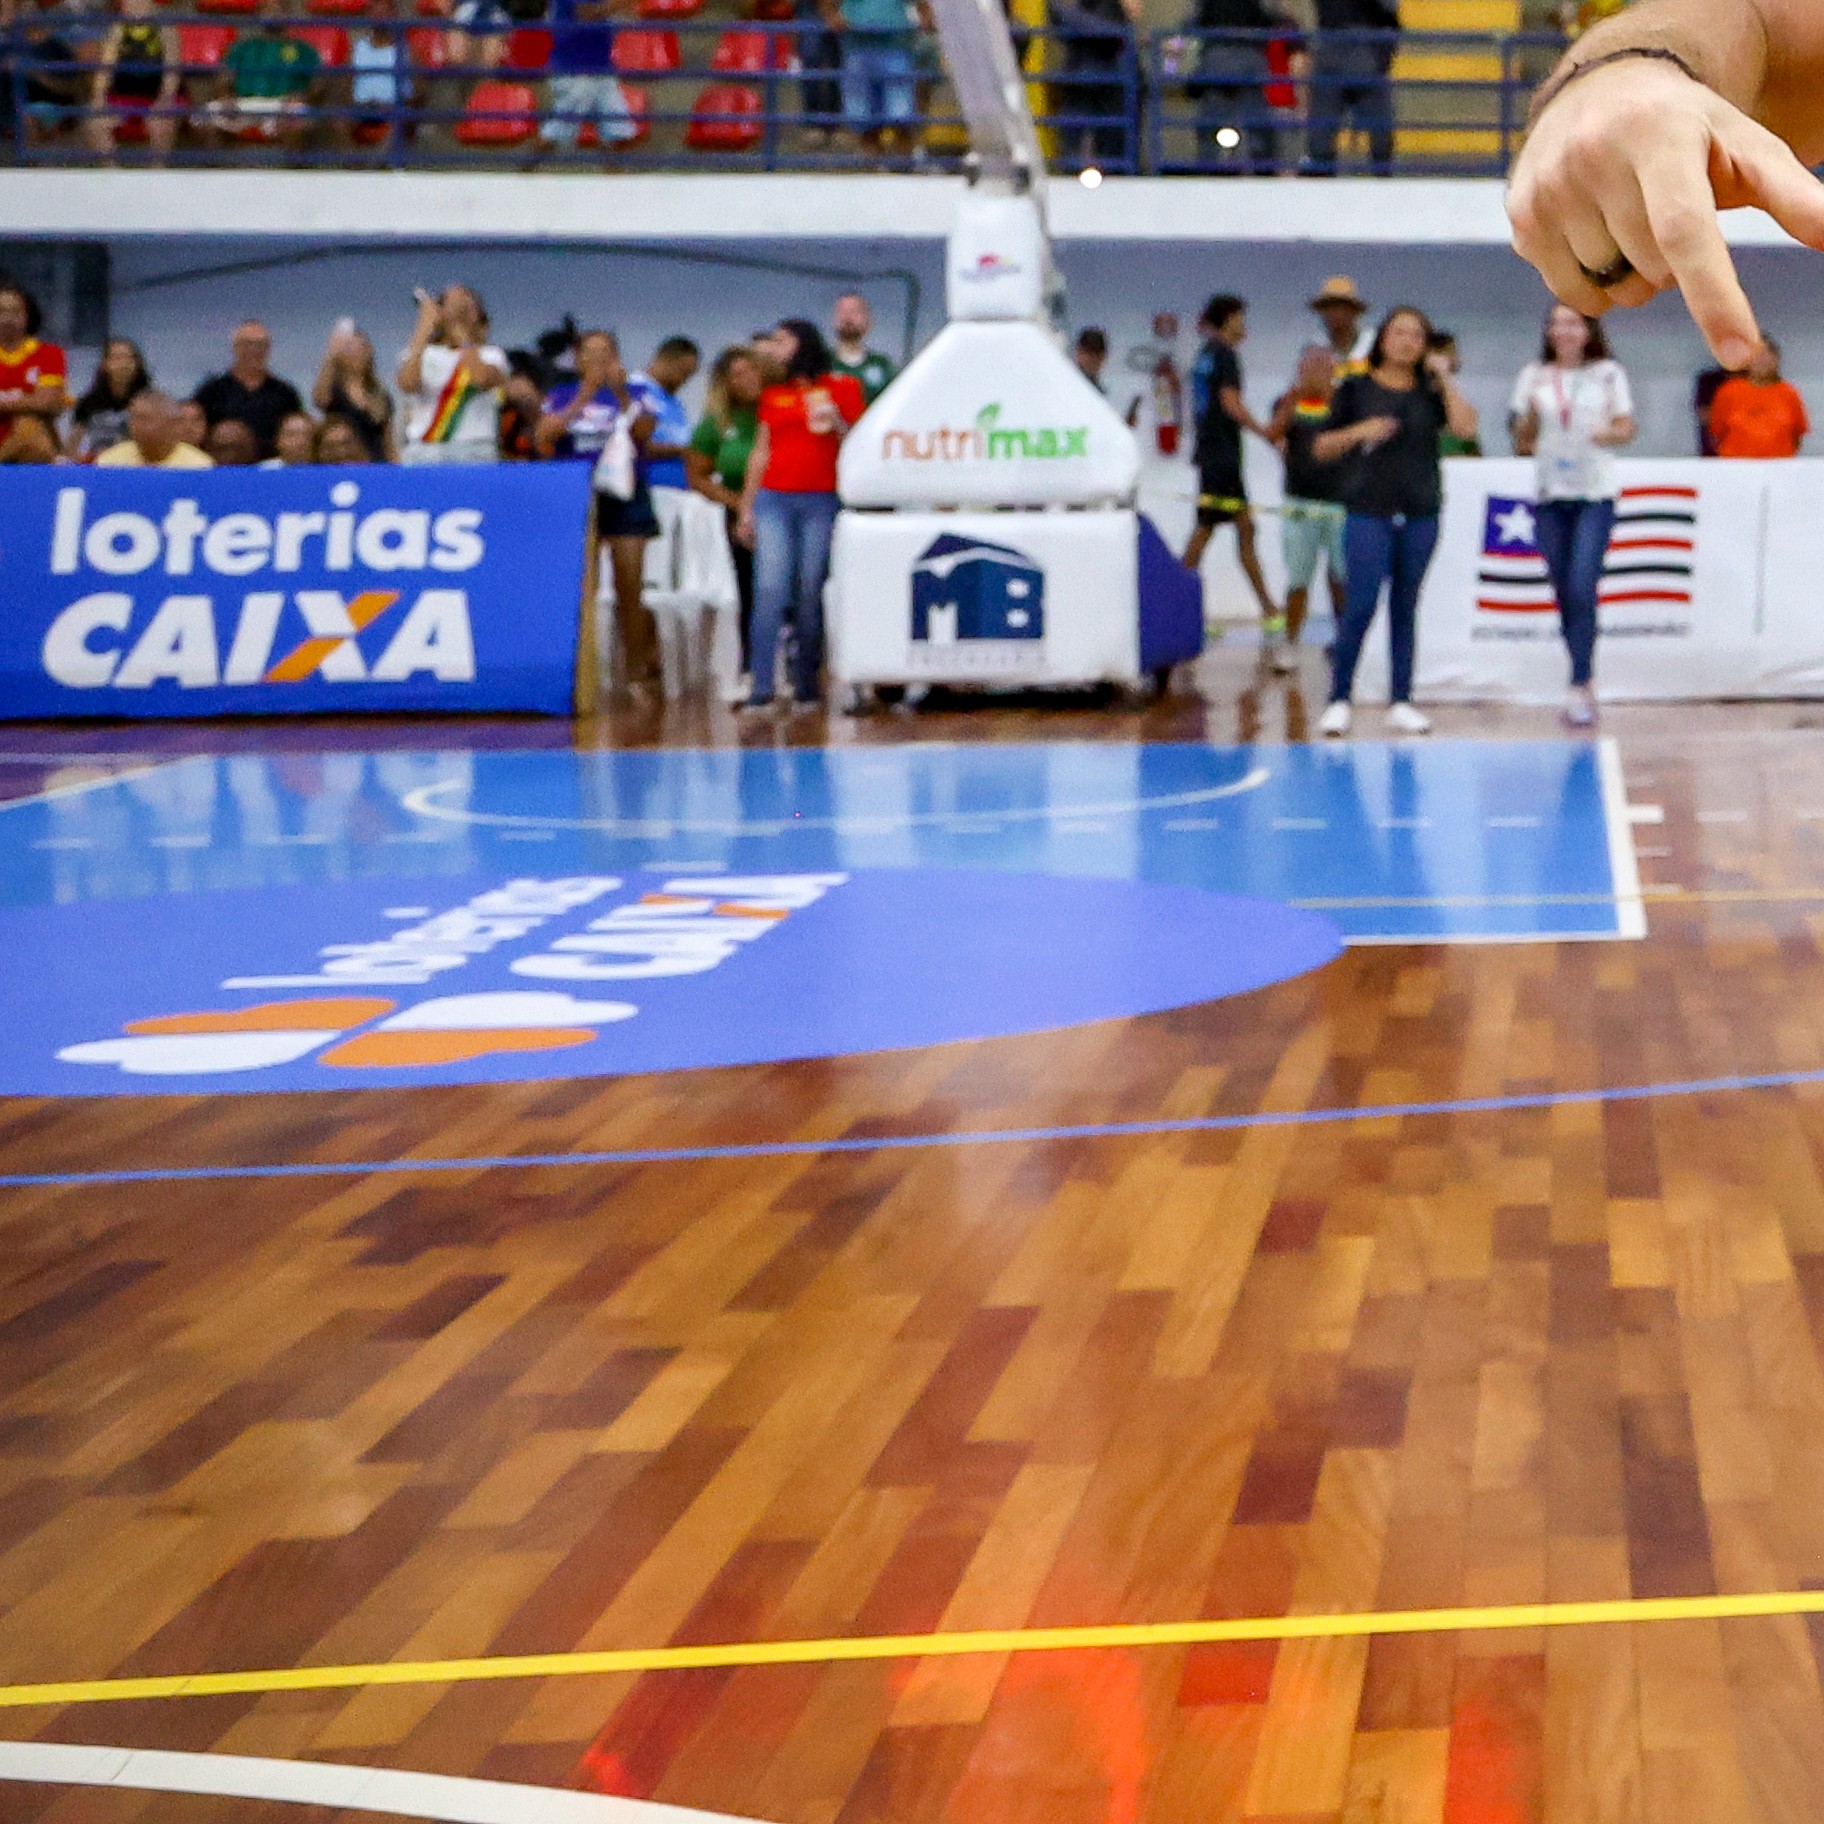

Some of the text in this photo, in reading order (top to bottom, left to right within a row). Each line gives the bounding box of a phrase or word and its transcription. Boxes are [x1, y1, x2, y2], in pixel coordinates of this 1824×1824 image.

[882, 426, 1088, 461] nutrimax
[51, 481, 484, 575] loterias
[42, 589, 475, 689] CAIXA
